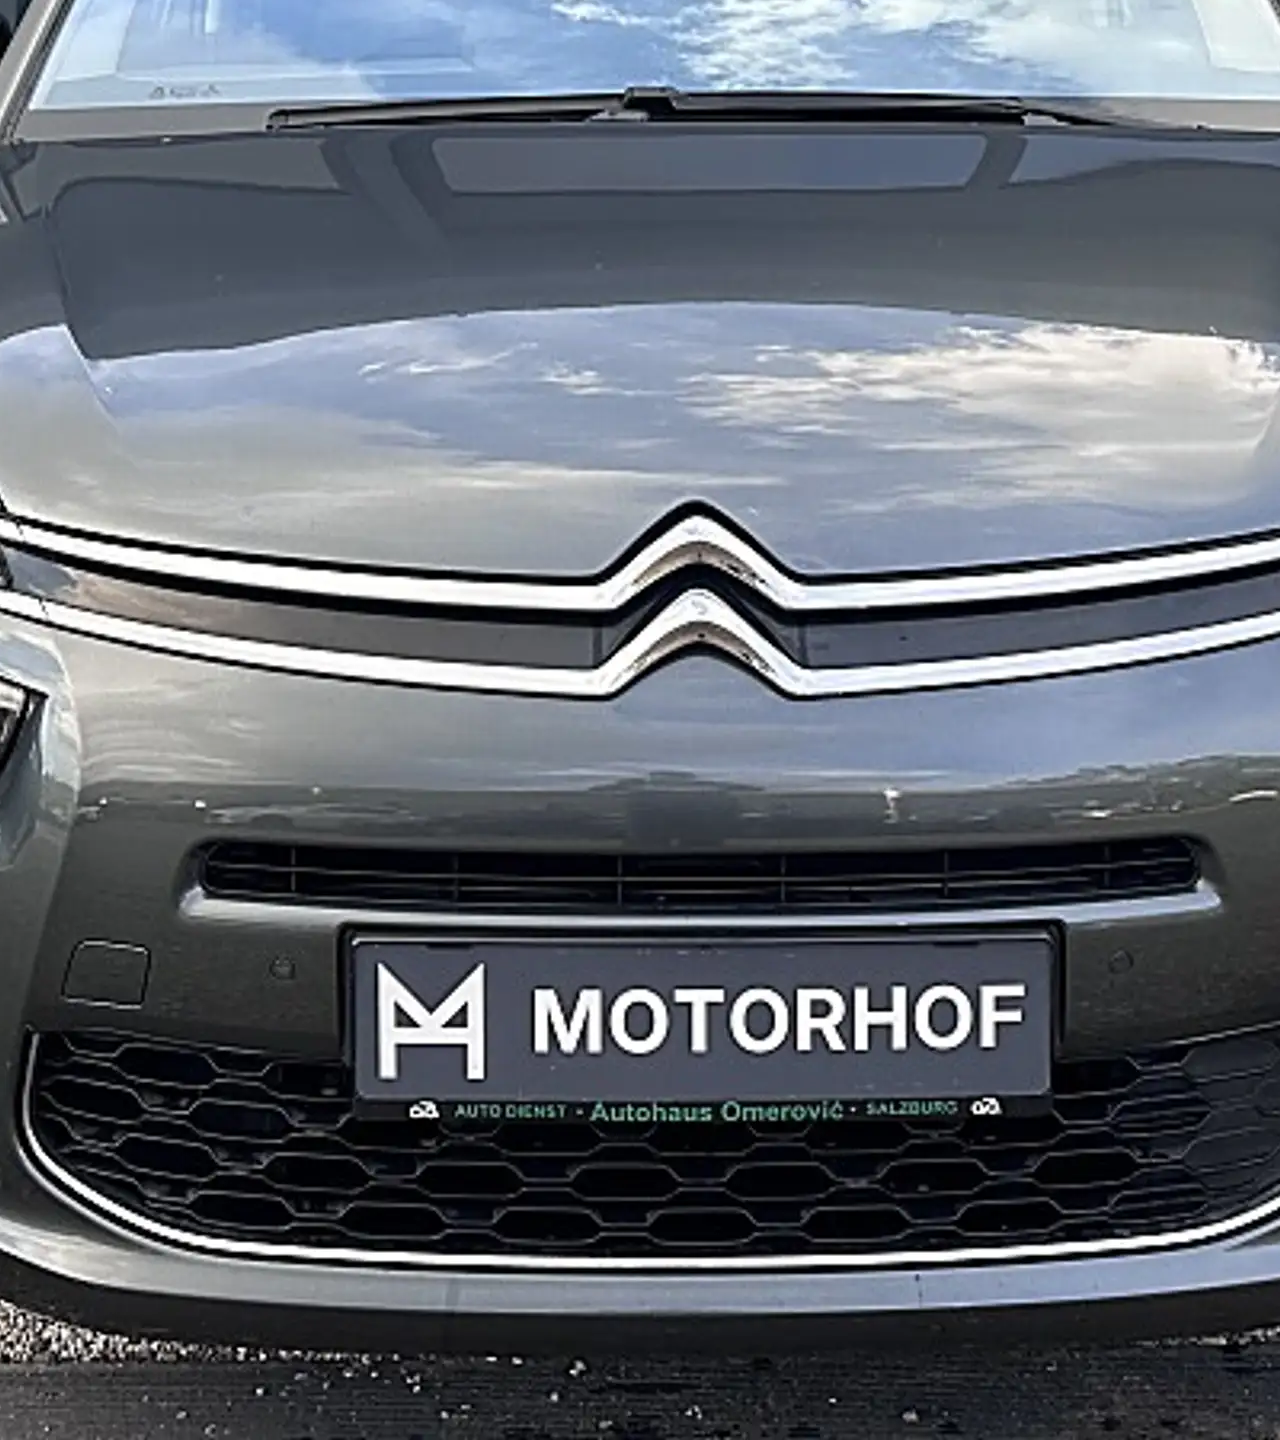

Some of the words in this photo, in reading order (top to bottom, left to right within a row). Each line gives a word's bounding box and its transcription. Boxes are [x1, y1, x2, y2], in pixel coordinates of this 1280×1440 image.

[534, 984, 1025, 1054] MOTORHOF
[453, 1103, 502, 1118] AUTO
[505, 1103, 566, 1118] DIENST
[590, 1101, 712, 1122] Autohaus
[721, 1099, 844, 1122] Omerović
[866, 1101, 958, 1116] SALZBURG
